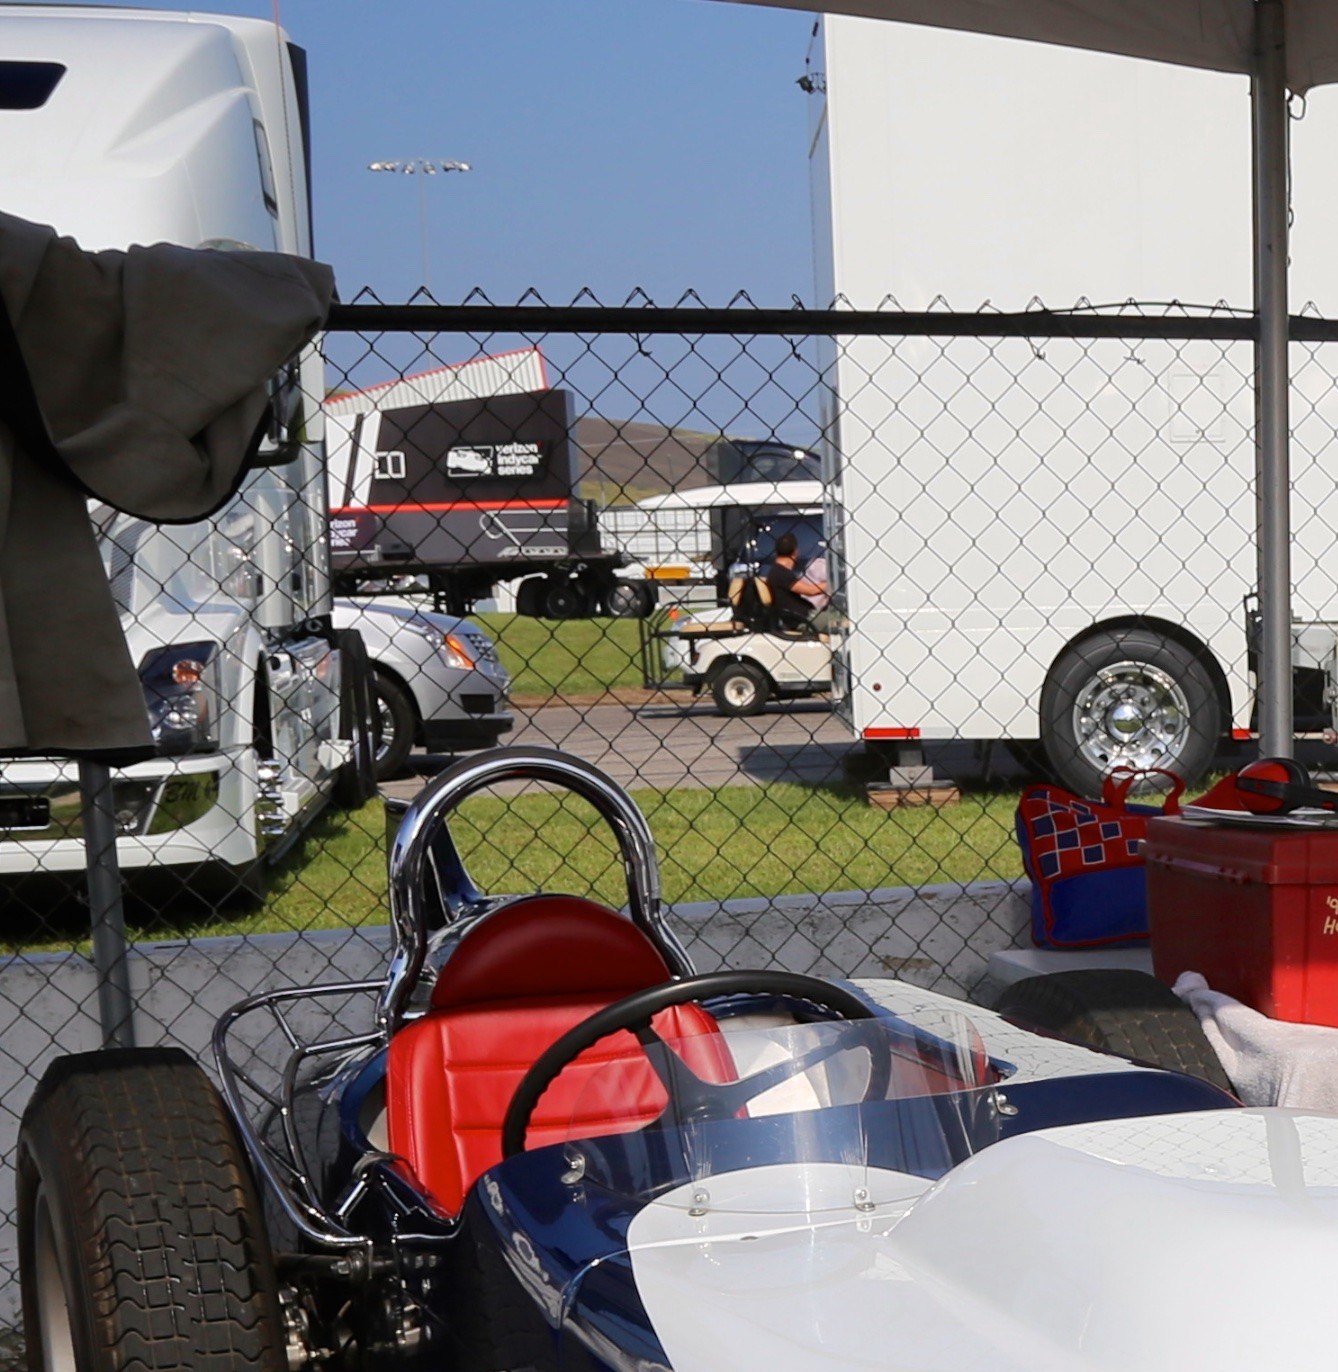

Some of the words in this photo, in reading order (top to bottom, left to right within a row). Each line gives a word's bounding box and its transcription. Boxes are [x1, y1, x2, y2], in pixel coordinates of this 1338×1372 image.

[495, 442, 538, 454] verizon
[497, 454, 540, 466] indycar
[497, 465, 533, 476] series
